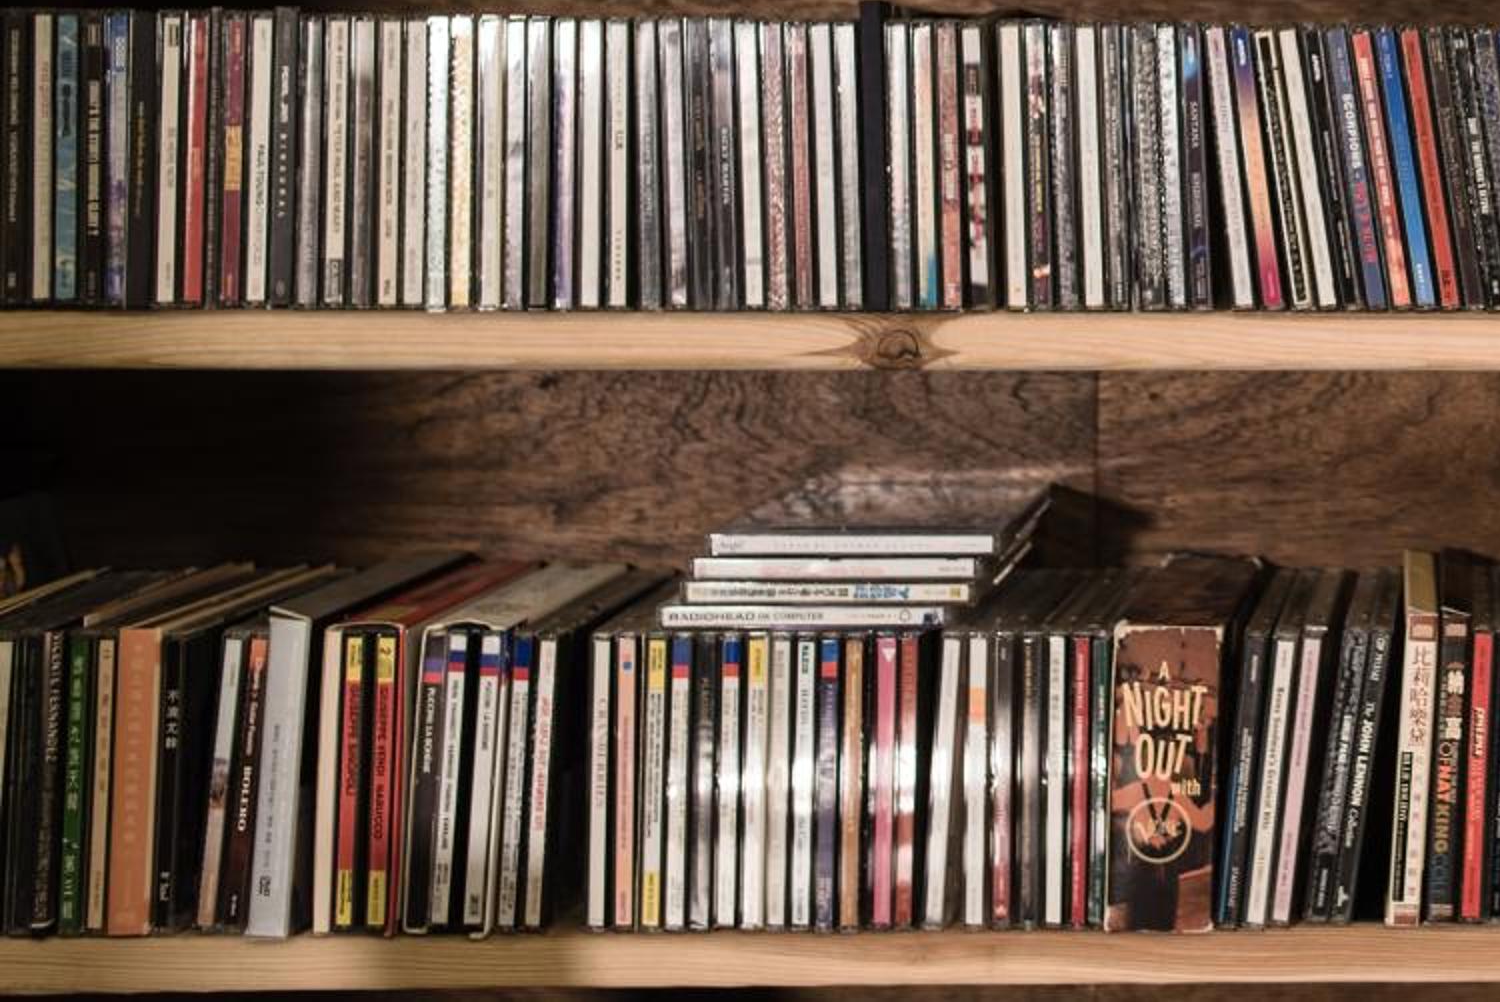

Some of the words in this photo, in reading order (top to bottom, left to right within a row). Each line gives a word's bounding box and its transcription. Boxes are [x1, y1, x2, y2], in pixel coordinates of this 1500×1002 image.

[1341, 93, 1364, 168] SCORPIONS
[668, 611, 754, 622] RADIOHEAD
[1158, 660, 1170, 680] A
[1121, 681, 1208, 730] NIGHT
[1135, 734, 1192, 781] OUT
[1358, 718, 1375, 752] JOHN
[1351, 755, 1370, 806] LENNON
[1434, 802, 1449, 853] KING
